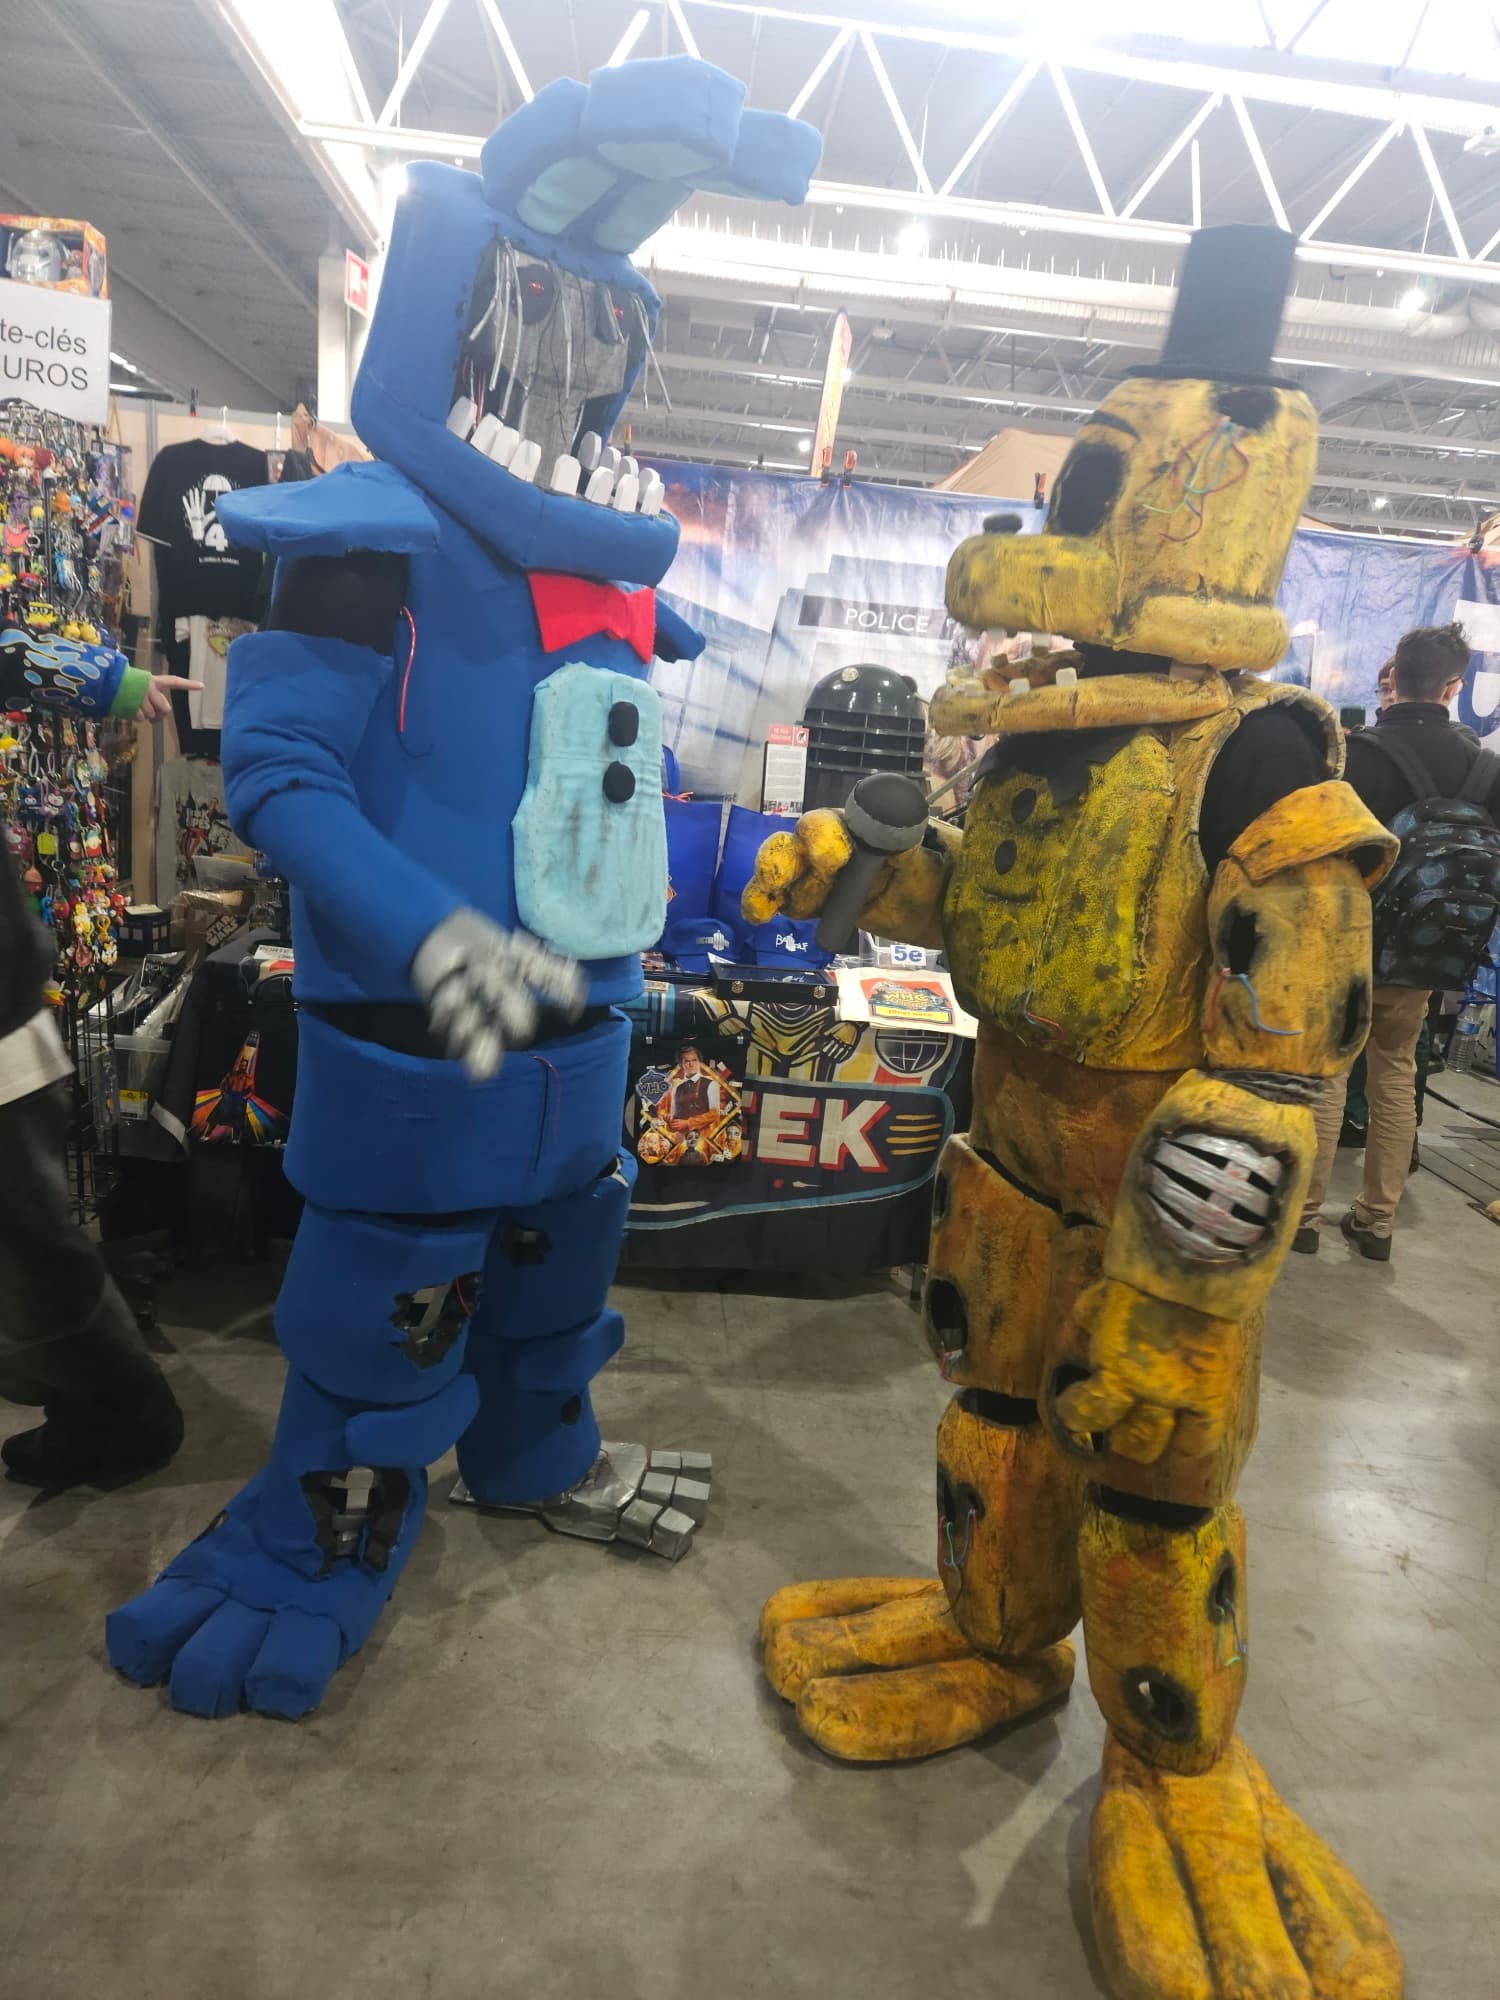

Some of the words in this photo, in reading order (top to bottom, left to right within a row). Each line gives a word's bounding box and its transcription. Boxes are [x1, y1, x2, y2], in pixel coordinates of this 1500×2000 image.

[0, 318, 87, 355] te-clés
[4, 354, 88, 391] UROS
[844, 608, 930, 633] POLICE
[206, 914, 231, 939] STAR
[894, 946, 922, 962] 5e
